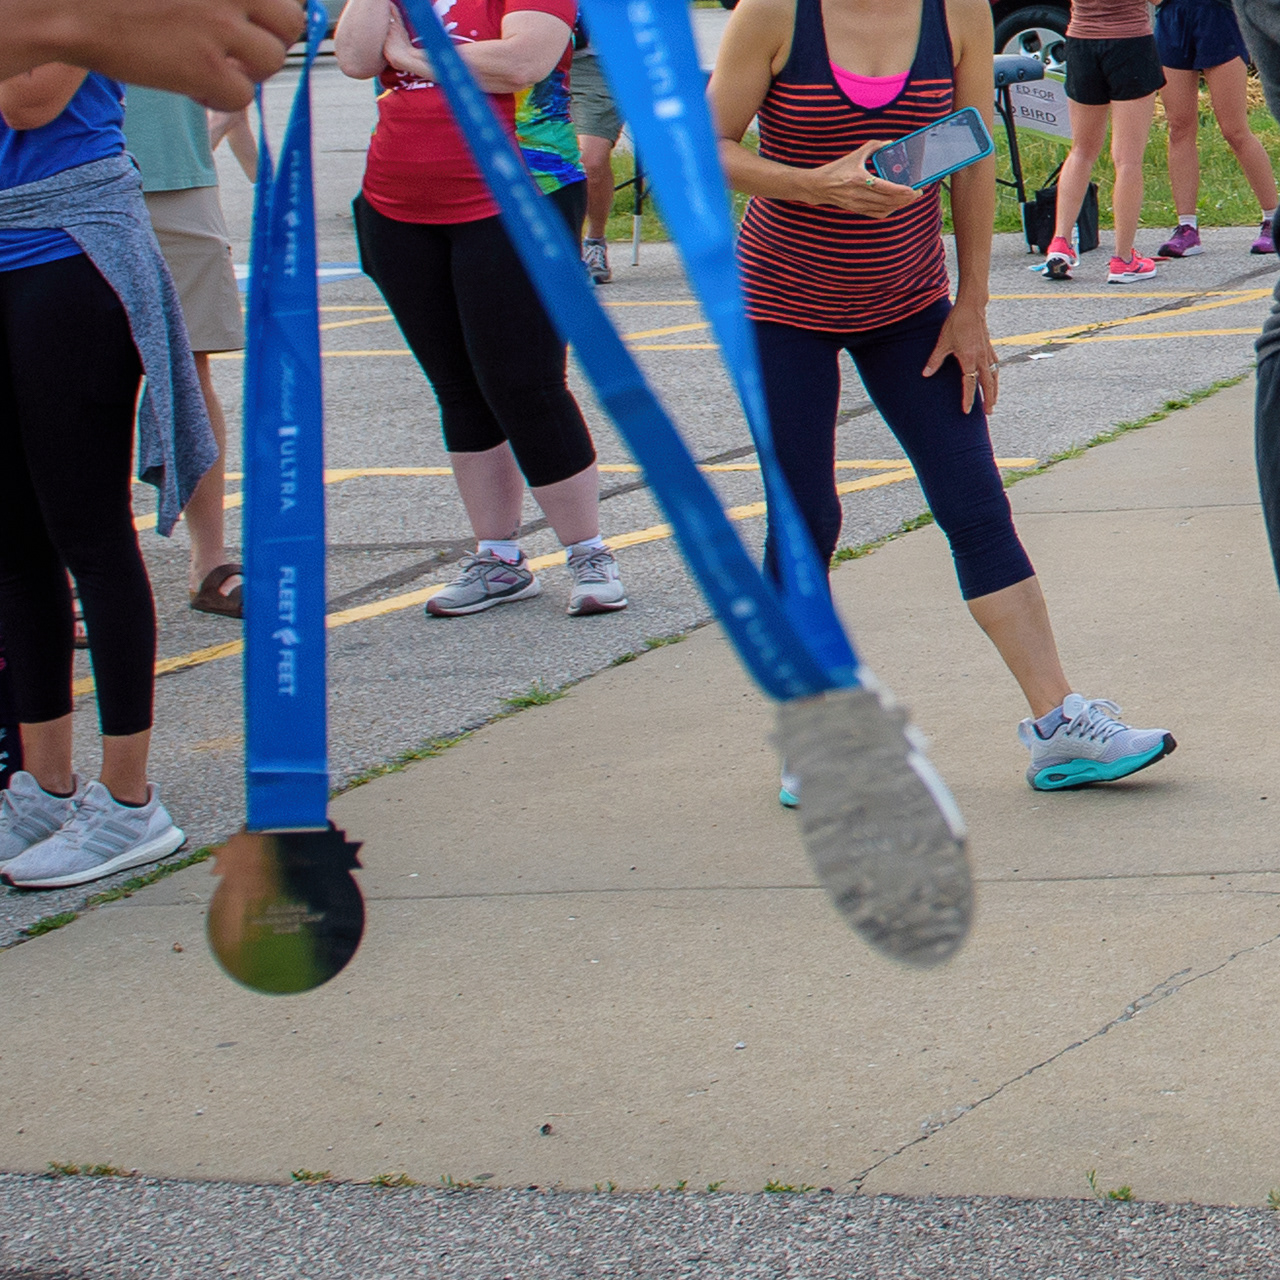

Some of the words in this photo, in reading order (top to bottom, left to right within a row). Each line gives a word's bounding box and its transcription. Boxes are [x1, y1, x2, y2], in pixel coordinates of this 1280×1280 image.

[1020, 106, 1057, 123] BIRD
[1033, 87, 1056, 100] FOR
[279, 440, 298, 513] ULTRA
[278, 565, 299, 624] FLEET
[277, 649, 298, 698] FEET
